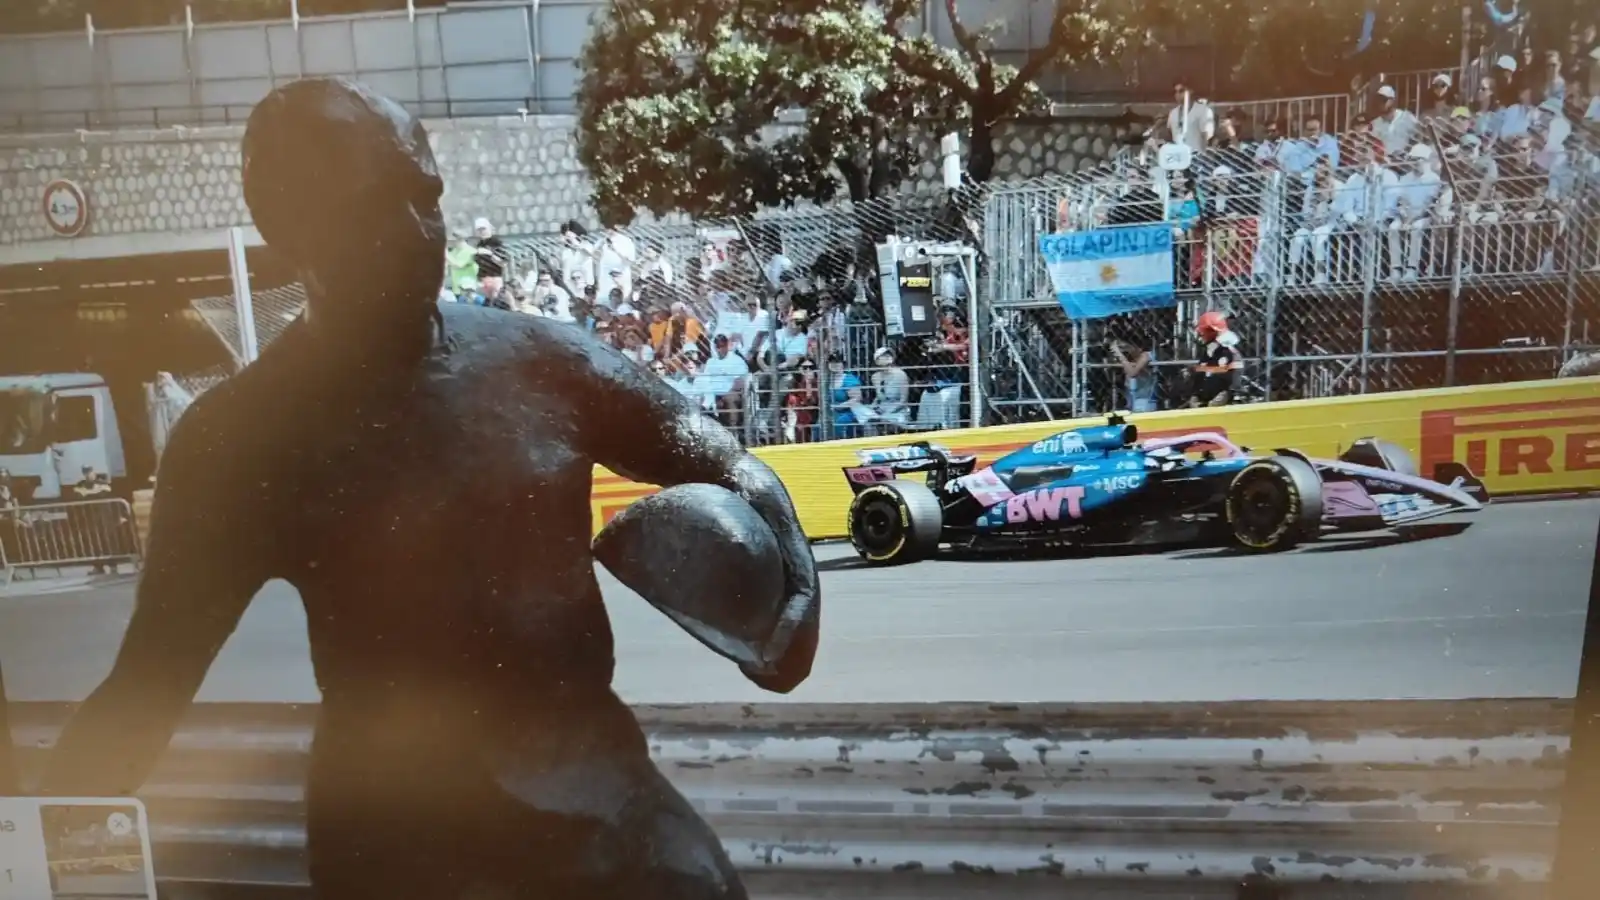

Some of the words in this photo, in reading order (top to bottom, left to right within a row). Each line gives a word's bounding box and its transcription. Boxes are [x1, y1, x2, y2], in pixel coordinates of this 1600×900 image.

[1032, 434, 1061, 454] eni
[1103, 474, 1140, 493] MSC
[1007, 486, 1085, 524] BWT
